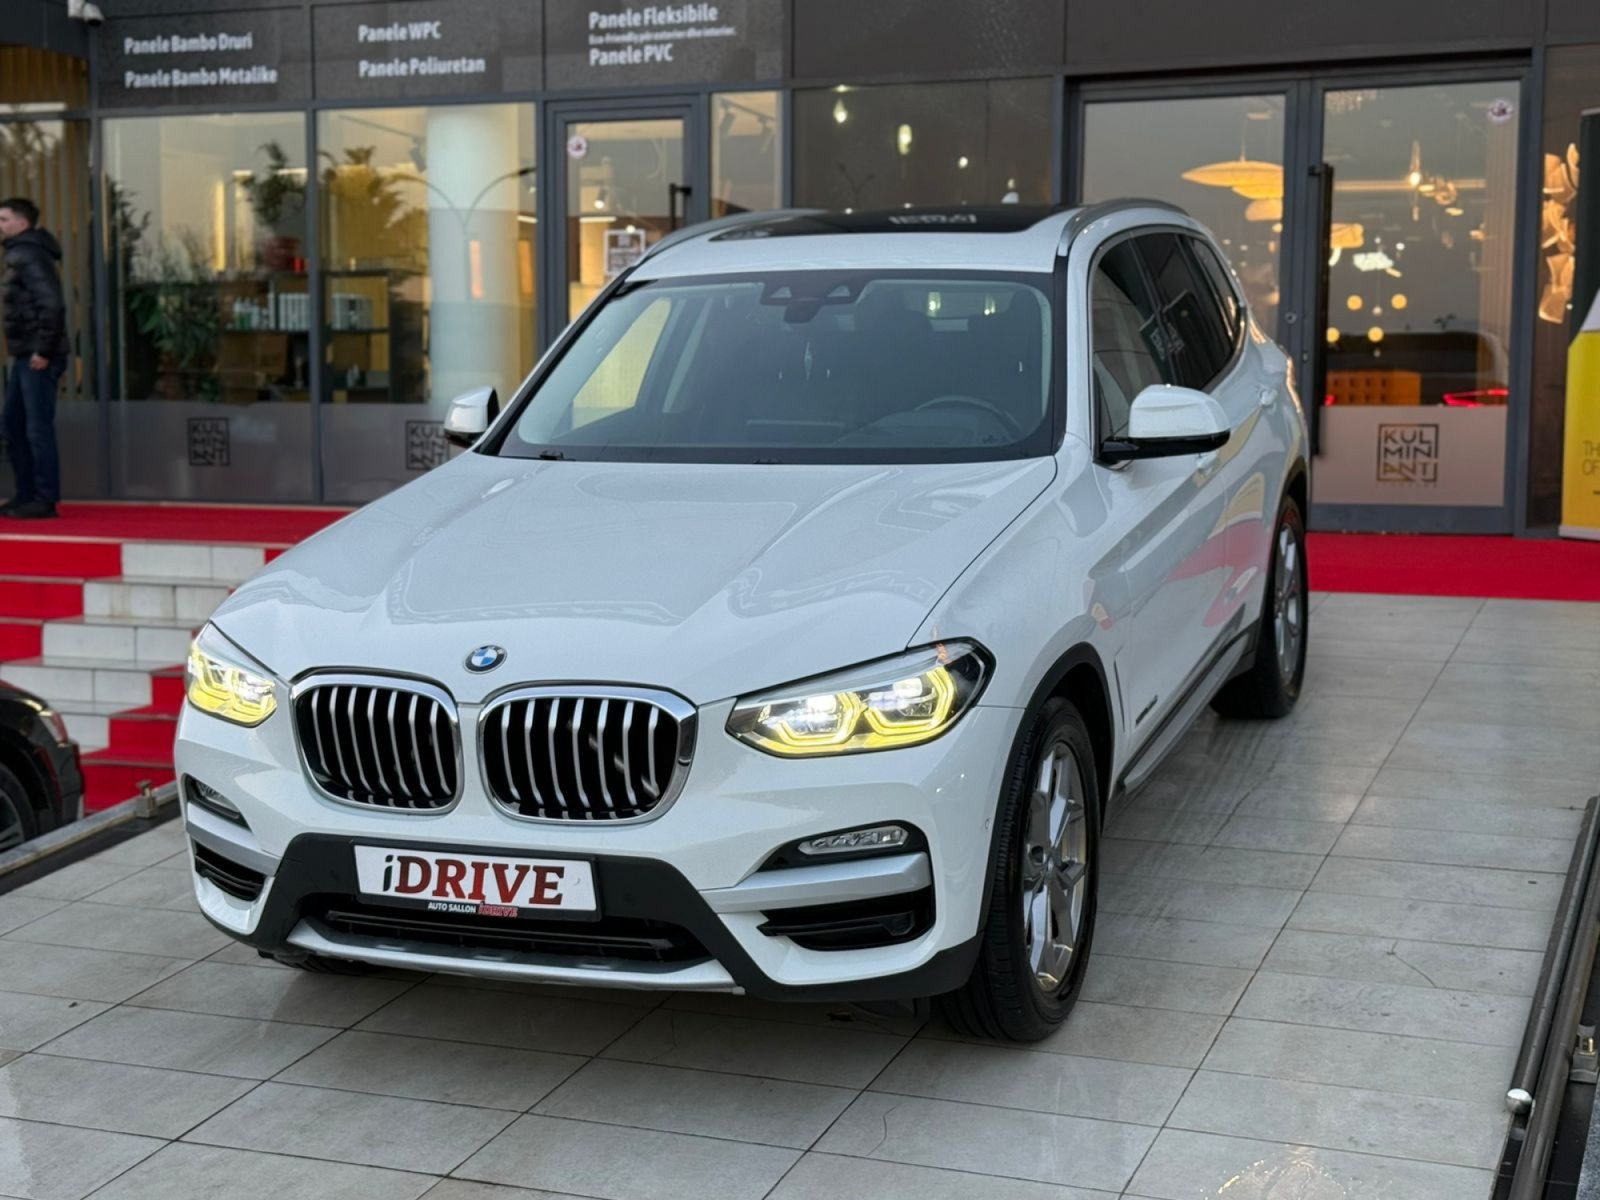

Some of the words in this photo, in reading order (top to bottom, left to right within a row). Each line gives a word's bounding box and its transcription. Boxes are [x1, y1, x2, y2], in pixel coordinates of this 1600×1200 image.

[588, 9, 642, 29] Panele
[643, 3, 718, 25] Fleksibile
[124, 35, 169, 54] Panele
[171, 33, 217, 52] Bambo
[218, 31, 253, 49] Druri
[358, 24, 408, 42] Panele
[408, 21, 442, 39] WPC
[589, 46, 642, 66] Panele
[643, 43, 673, 62] PVC
[125, 69, 170, 88] Panele
[171, 68, 218, 86] Bambo
[219, 65, 278, 84] Metalike
[359, 58, 408, 77] Panele
[409, 56, 486, 75] Poliuretan
[1383, 429, 1432, 444] KUL
[1383, 445, 1432, 459] MIN
[382, 854, 565, 905] iDRIVE
[427, 902, 447, 912] AUTO
[448, 904, 477, 914] SALLON
